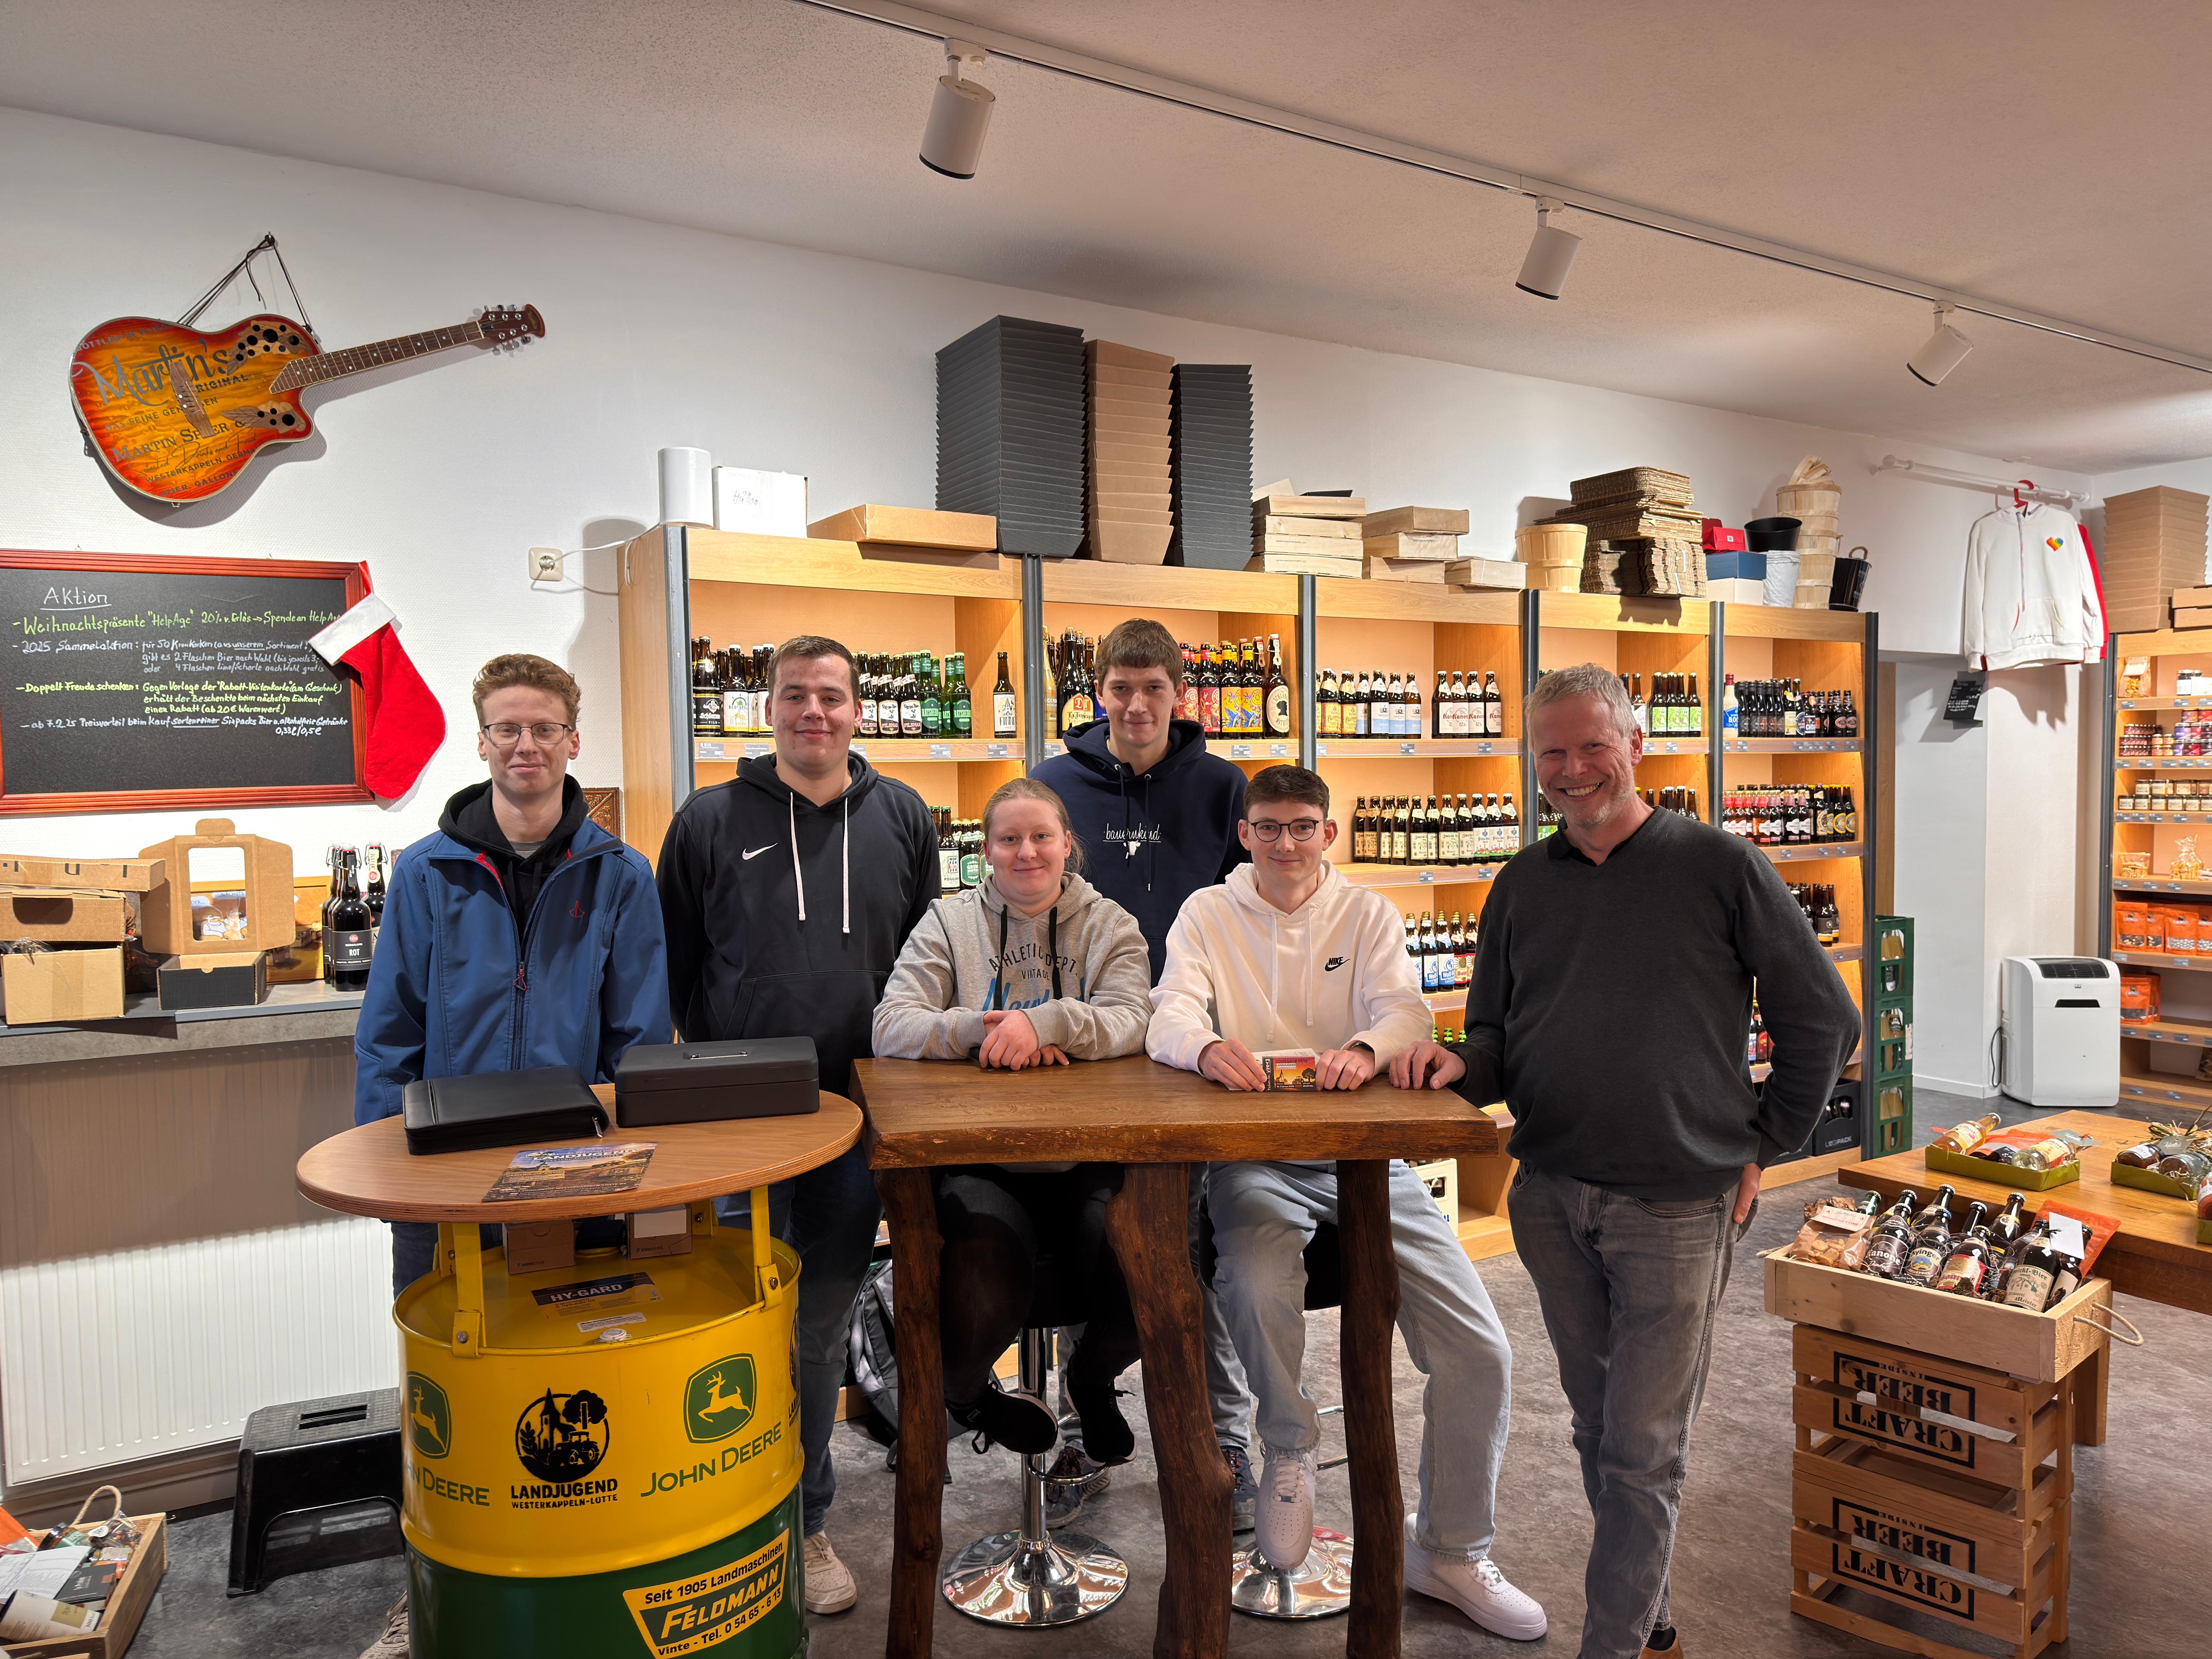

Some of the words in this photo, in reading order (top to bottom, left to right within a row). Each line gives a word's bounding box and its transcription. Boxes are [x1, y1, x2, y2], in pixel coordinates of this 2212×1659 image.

[72, 338, 229, 407] Martn's
[195, 374, 249, 393] RIGINAL
[104, 419, 126, 432] DAS
[129, 410, 159, 427] FEINE
[111, 436, 176, 462] MARTIN
[214, 441, 229, 454] and
[733, 491, 758, 505] Hüllen
[44, 586, 108, 605] Aktion
[231, 611, 251, 623] Erlös
[309, 610, 342, 625] HelpA
[142, 640, 156, 653] für
[142, 652, 159, 664] gibt
[182, 652, 214, 661] Flaschen
[217, 651, 233, 661] Bier
[235, 652, 253, 662] nach
[254, 652, 271, 662] Wahl
[287, 653, 310, 663] jeweils
[175, 663, 181, 672] 4
[182, 663, 214, 672] Flaschen
[265, 664, 283, 673] nach
[283, 663, 300, 673] Wahl
[302, 665, 324, 674] gratis
[65, 681, 95, 691] Freude
[143, 682, 168, 694] Gegen
[169, 681, 199, 694] Vorlage
[201, 680, 217, 691] der
[143, 693, 173, 704] erhält
[175, 694, 191, 703] der
[191, 693, 237, 703] Beschenkte
[238, 693, 255, 703] beim
[257, 693, 290, 703] nächsten
[292, 693, 324, 706] Einkauf
[145, 706, 168, 714] einen
[170, 704, 200, 713] Rabatt
[79, 717, 125, 727] Preisvorteil
[127, 717, 146, 726] beim
[148, 716, 172, 728] Kauf
[258, 716, 273, 726] Bier
[316, 717, 348, 727] Getränke
[922, 708, 939, 717] RATSHER
[349, 948, 360, 957] ROT
[988, 943, 1043, 972] ATHLETIC
[1046, 954, 1078, 976] DEPT.
[1328, 957, 1344, 966] NIKE
[1021, 968, 1050, 981] VINTAGE
[534, 1150, 637, 1160] LANDJUGEND
[550, 1284, 623, 1303] HY-GARD
[1852, 1366, 1952, 1416] BEER
[1844, 1402, 1963, 1453] CRAFT
[640, 1458, 716, 1498] JOHN
[721, 1420, 782, 1473] DEERE
[423, 1465, 490, 1507] DEERE
[510, 1478, 618, 1500] LANDJUGEND
[511, 1494, 618, 1509] WESTERKAPPELN-LOTTE
[1852, 1514, 1952, 1567] BEER
[645, 1589, 673, 1605] Seit
[677, 1579, 707, 1597] 1905
[711, 1541, 783, 1588] Landmaschinen
[1844, 1548, 1963, 1605] CRAFT
[661, 1563, 779, 1639] FELDMANN
[658, 1643, 690, 1656] Vinte
[701, 1628, 722, 1644] Tel.
[725, 1622, 731, 1633] 0
[734, 1617, 746, 1629] 54
[748, 1608, 759, 1621] 65
[766, 1596, 772, 1607] 6
[773, 1586, 781, 1602] 13
